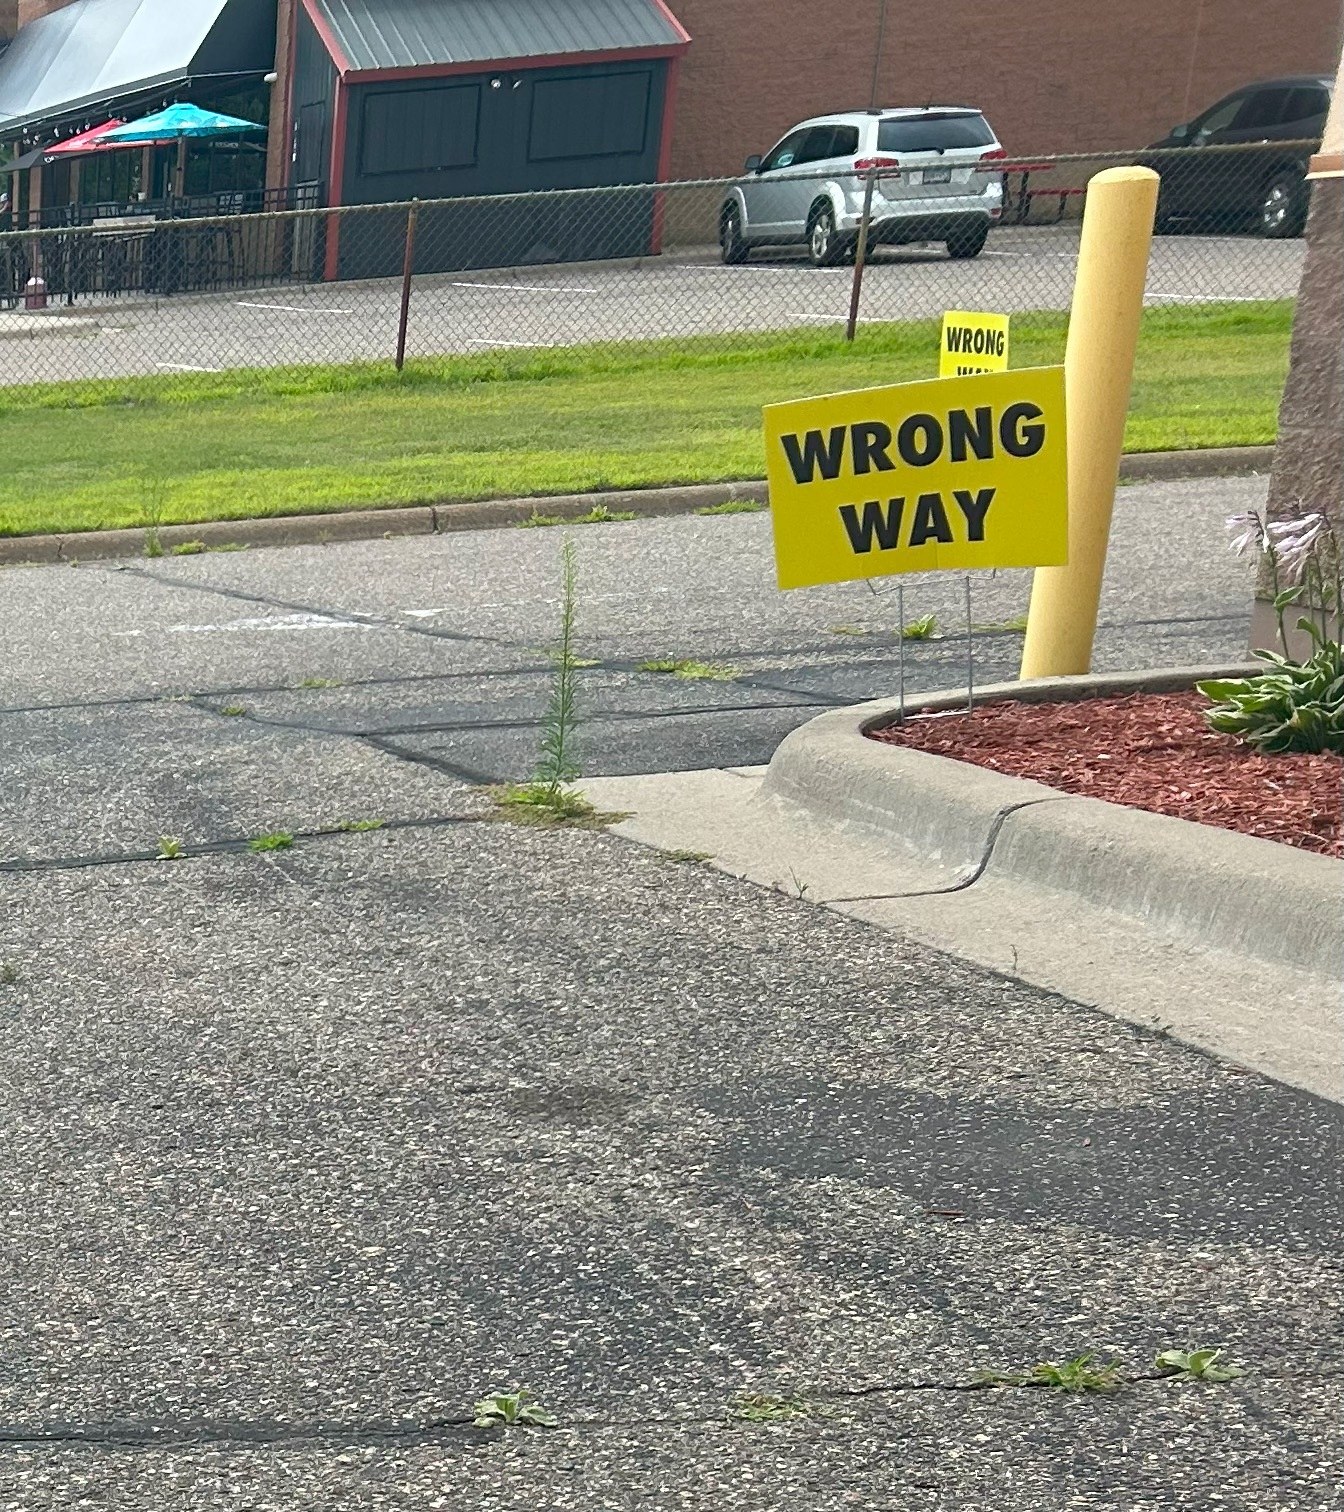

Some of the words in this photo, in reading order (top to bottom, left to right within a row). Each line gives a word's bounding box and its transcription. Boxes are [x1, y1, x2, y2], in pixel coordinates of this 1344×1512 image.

[946, 326, 1005, 357] WRONG
[780, 402, 1046, 485] WRONG
[838, 488, 997, 555] WAY
